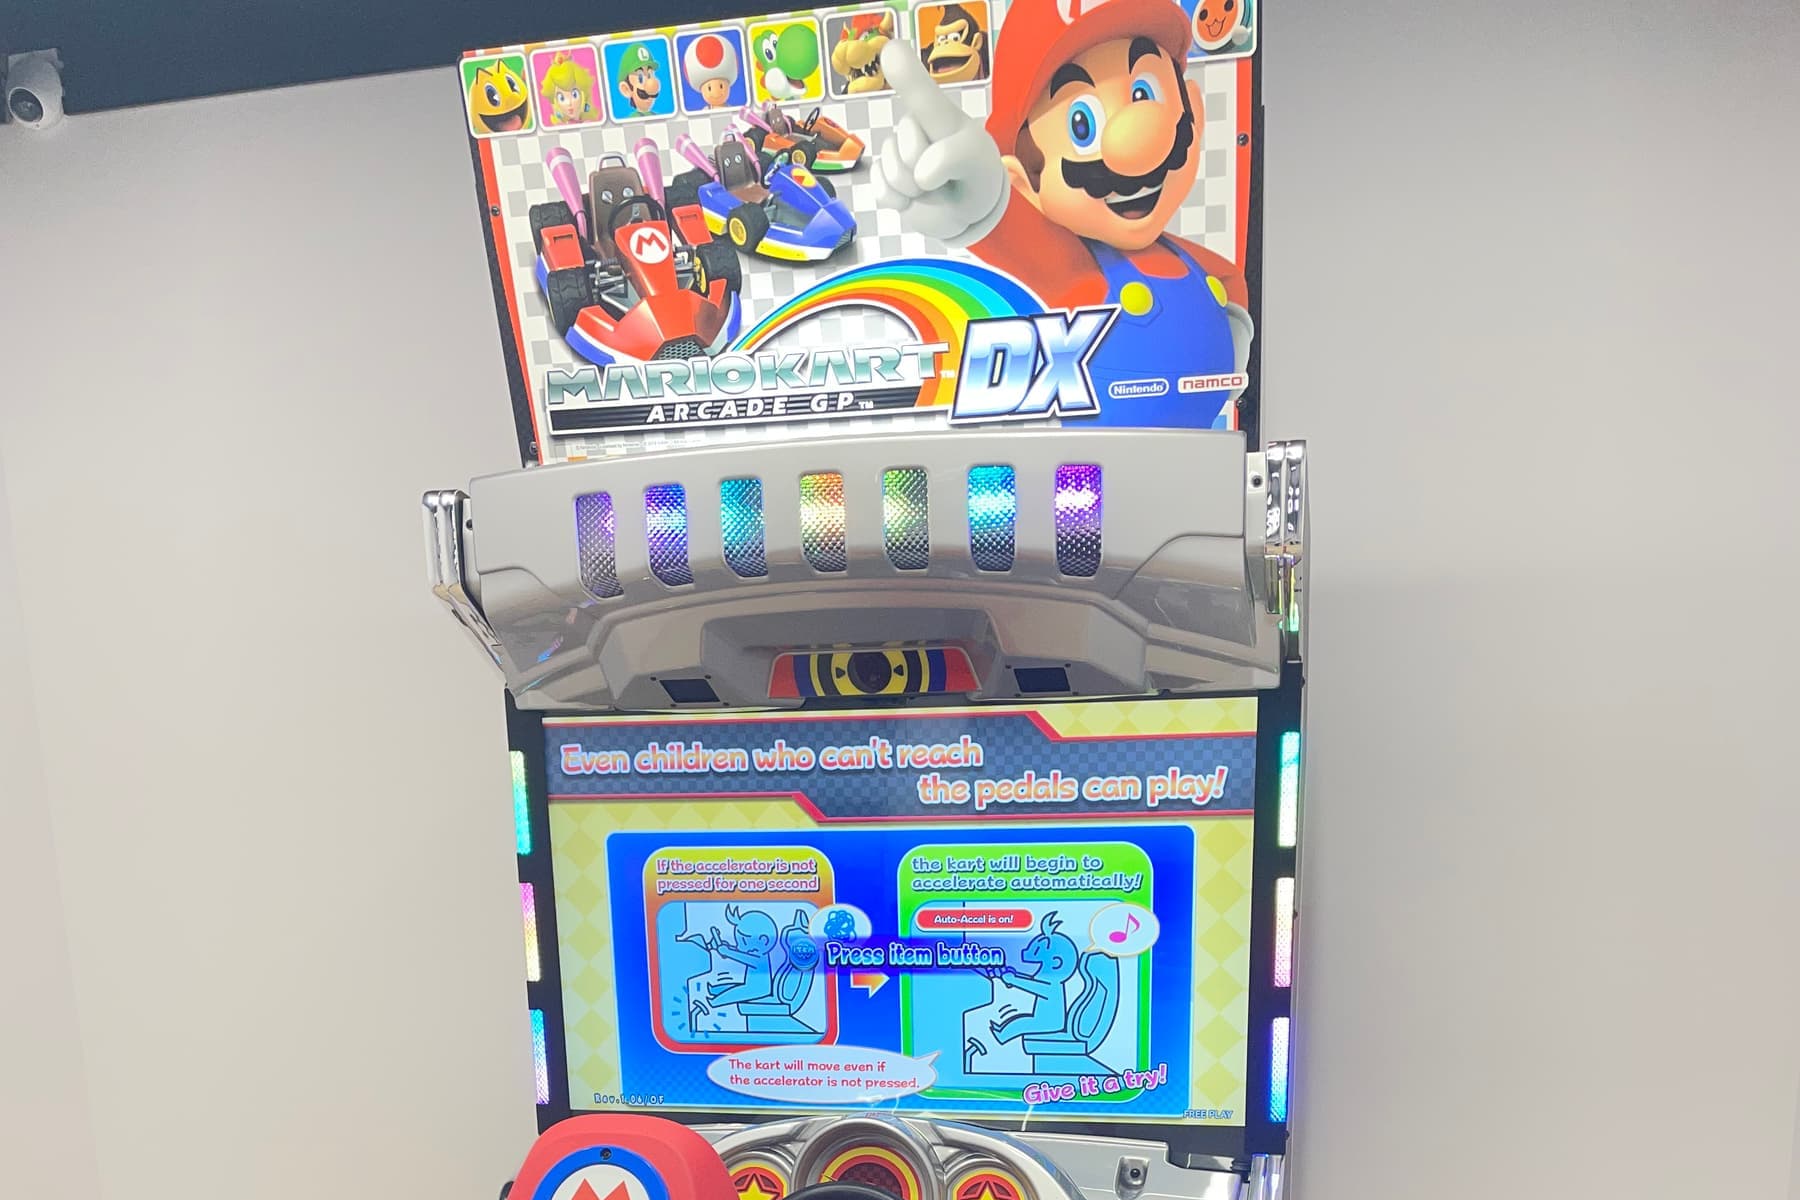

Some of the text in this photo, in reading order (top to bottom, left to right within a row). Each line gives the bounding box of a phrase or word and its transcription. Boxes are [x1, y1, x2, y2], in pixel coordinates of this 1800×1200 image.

[951, 305, 1120, 420] DX
[1112, 382, 1166, 396] Nintendo
[1181, 376, 1243, 390] namco
[646, 400, 789, 424] ARCADE
[811, 391, 856, 412] GP
[561, 735, 983, 774] Even children who can't reach
[919, 766, 1228, 810] the pedals can play!
[657, 858, 815, 872] If the accelerator is not
[912, 855, 1102, 873] the kart will begin to
[657, 875, 818, 893] pressed for one second
[912, 873, 1143, 891] accelerate automatically!
[934, 914, 1014, 924] Auto-Accel is on!
[825, 940, 1005, 966] Press item button
[728, 1058, 886, 1072] The kart will move even if
[730, 1075, 920, 1090] the accelerator is not pressed.
[1024, 1064, 1167, 1104] Give it a try!
[1183, 1109, 1234, 1120] FREE PLAY
